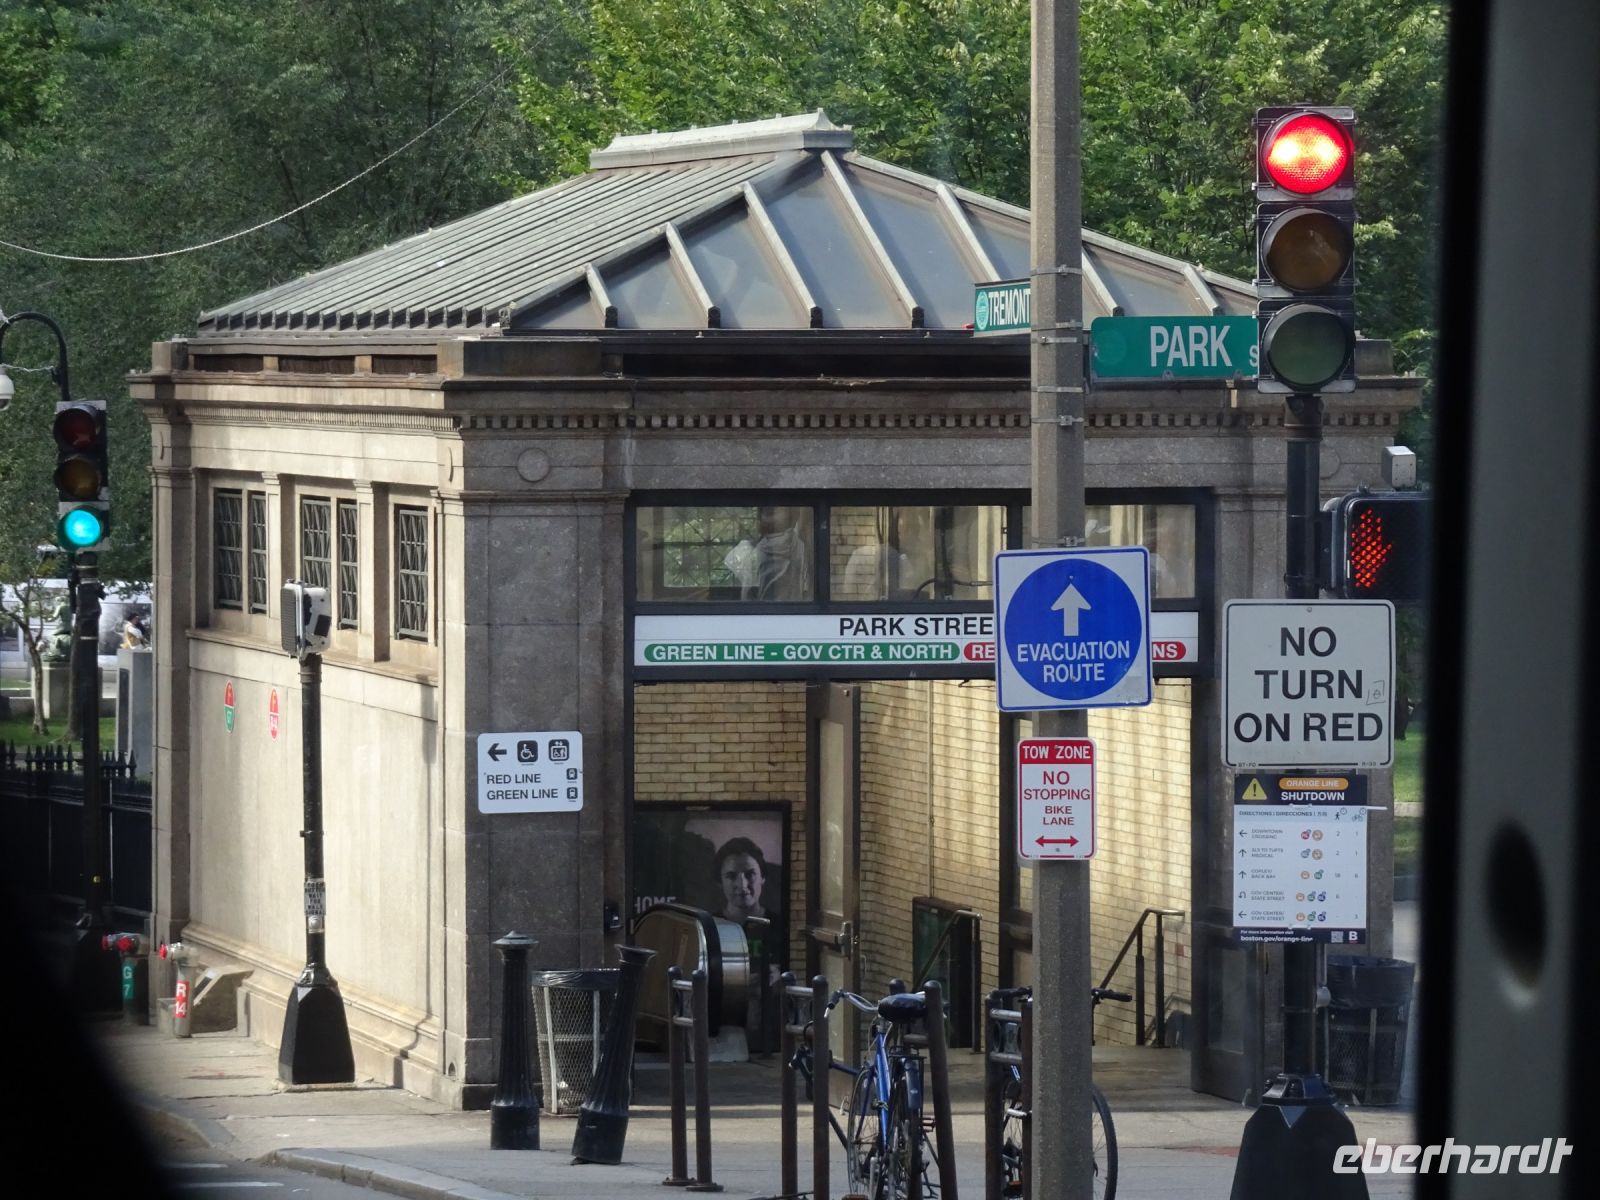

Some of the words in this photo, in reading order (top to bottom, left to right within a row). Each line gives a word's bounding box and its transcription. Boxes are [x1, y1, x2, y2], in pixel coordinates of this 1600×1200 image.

[989, 288, 1031, 326] TREMONT
[1150, 326, 1233, 367] PARK
[1249, 344, 1258, 368] S
[839, 617, 905, 636] PARK
[914, 616, 994, 636] STREE
[1280, 626, 1337, 657] NO
[653, 645, 717, 660] GREEN
[723, 645, 765, 660] LINE
[783, 645, 823, 660] GOV
[828, 645, 865, 659] CTR
[870, 645, 883, 659] &
[888, 644, 952, 659] NORTH
[971, 645, 995, 659] RE
[1017, 640, 1130, 662] EVACUATION
[1043, 662, 1105, 683] ROUTE
[1254, 669, 1363, 700] TURN
[1233, 712, 1290, 743] ON
[1303, 712, 1383, 742] RED
[1022, 745, 1049, 759] TOW
[1055, 745, 1091, 759] ZONE
[486, 774, 512, 784] RED
[514, 773, 541, 783] LINE
[1042, 770, 1070, 785] NO
[1286, 779, 1320, 787] ORANGE
[1321, 779, 1339, 787] LINE
[486, 789, 528, 800] GREEN
[532, 788, 558, 799] LINE
[1023, 788, 1091, 800] STOPPING
[1281, 791, 1345, 801] SHUTDOWN
[1044, 805, 1073, 815] BIKE
[1042, 816, 1075, 826] LANE
[1349, 931, 1358, 941] B
[123, 966, 133, 979] G
[123, 984, 131, 998] 7
[176, 983, 187, 997] R
[175, 1000, 186, 1015] 14
